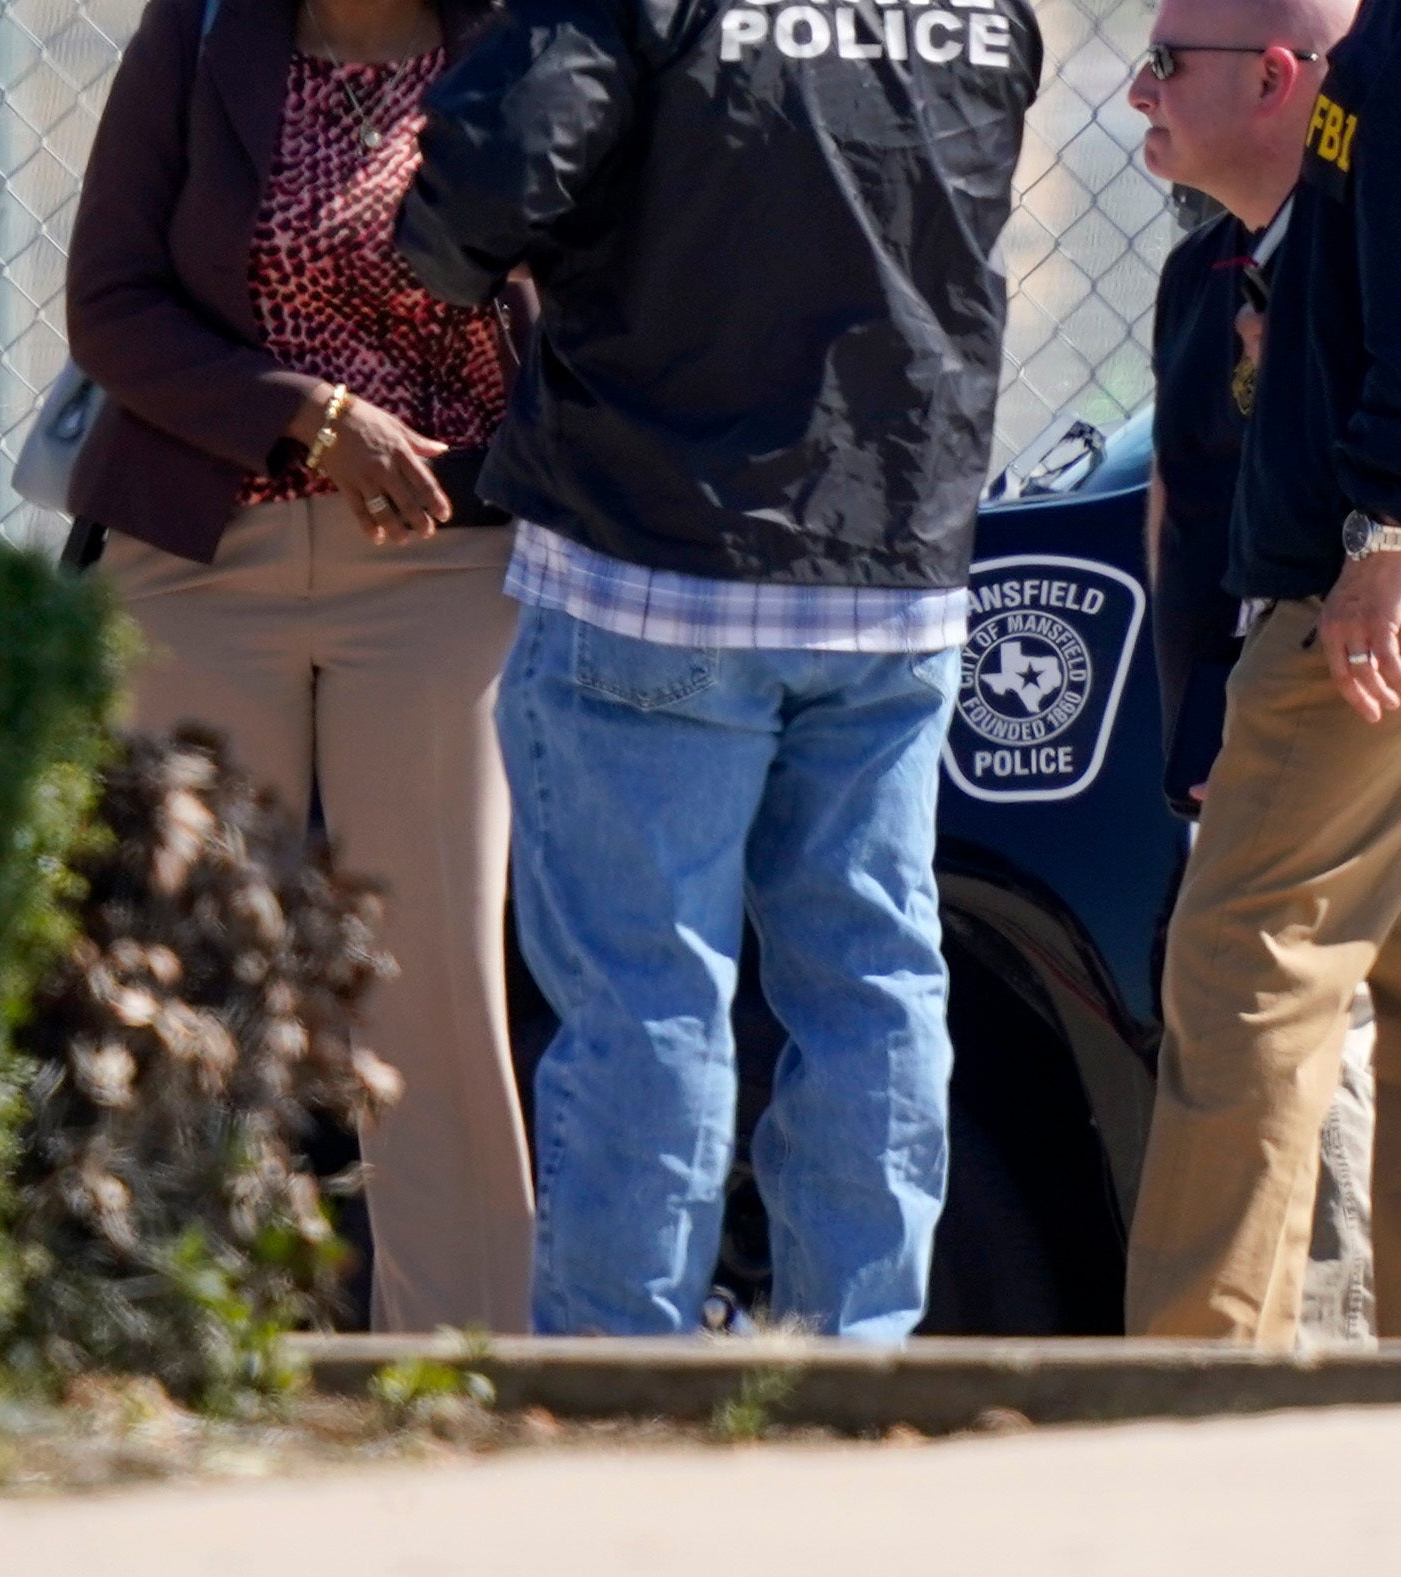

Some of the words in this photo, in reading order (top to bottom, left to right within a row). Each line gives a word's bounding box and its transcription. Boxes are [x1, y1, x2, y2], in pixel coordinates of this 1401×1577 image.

[720, 6, 1011, 68] POLICE
[1305, 93, 1358, 173] FBI
[966, 580, 1105, 615] ANSFIELD
[960, 647, 980, 689] CITY
[975, 623, 999, 647] OF
[1007, 614, 1087, 682] MANSFIELD
[962, 697, 1046, 740] FOUNDED
[1046, 691, 1081, 728] 1860
[974, 746, 1073, 777] POLICE
